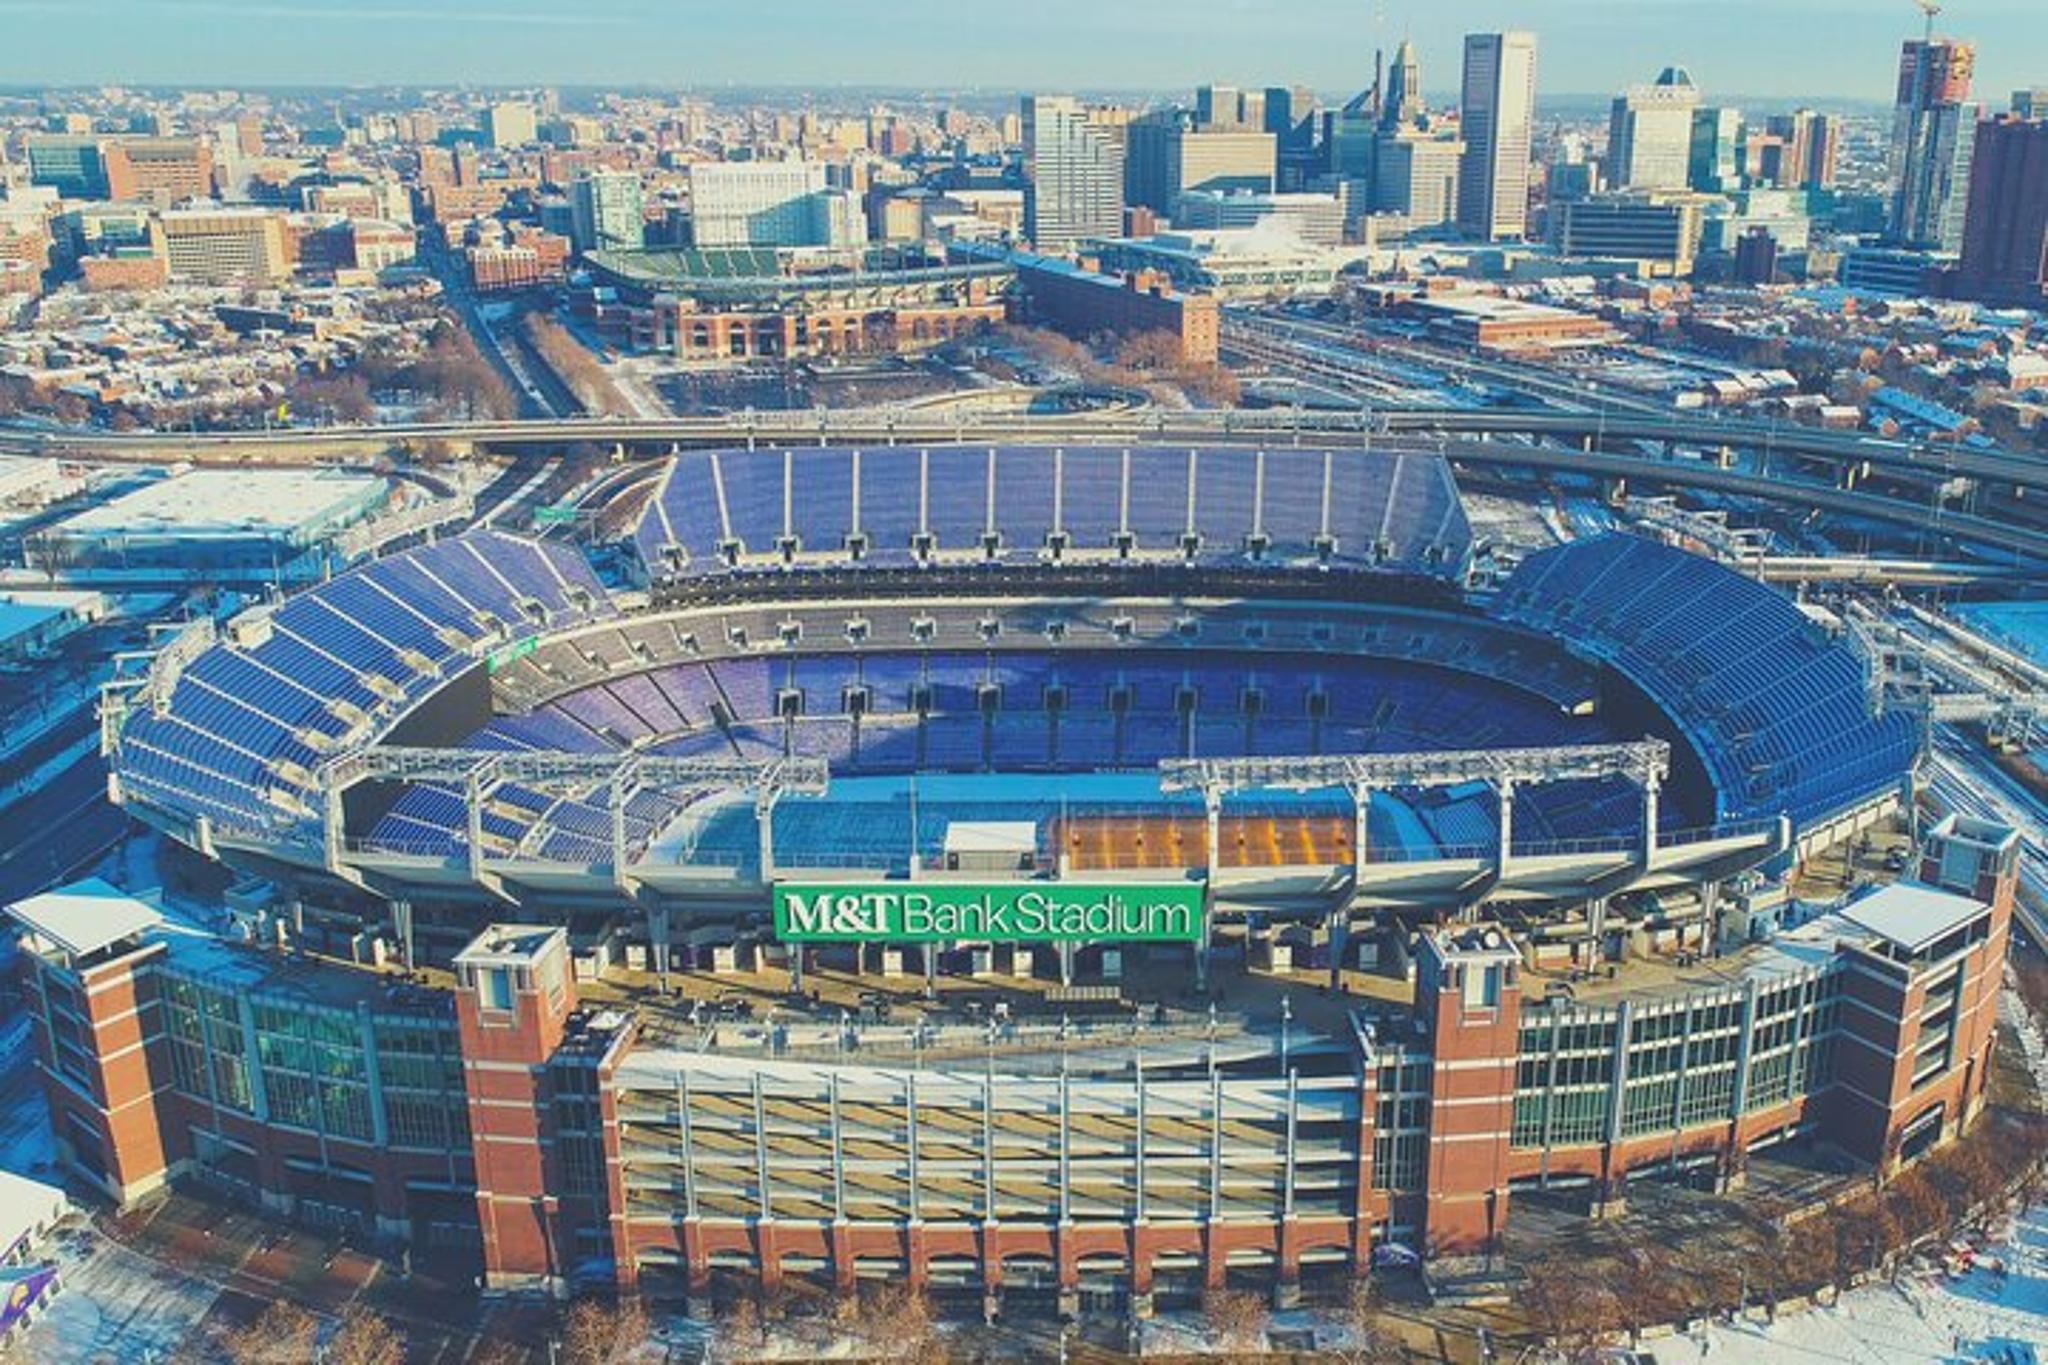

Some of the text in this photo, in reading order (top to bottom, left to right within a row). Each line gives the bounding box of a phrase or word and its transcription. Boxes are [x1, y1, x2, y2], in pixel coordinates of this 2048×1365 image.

[786, 892, 1190, 933] M&T Bank Stadium
